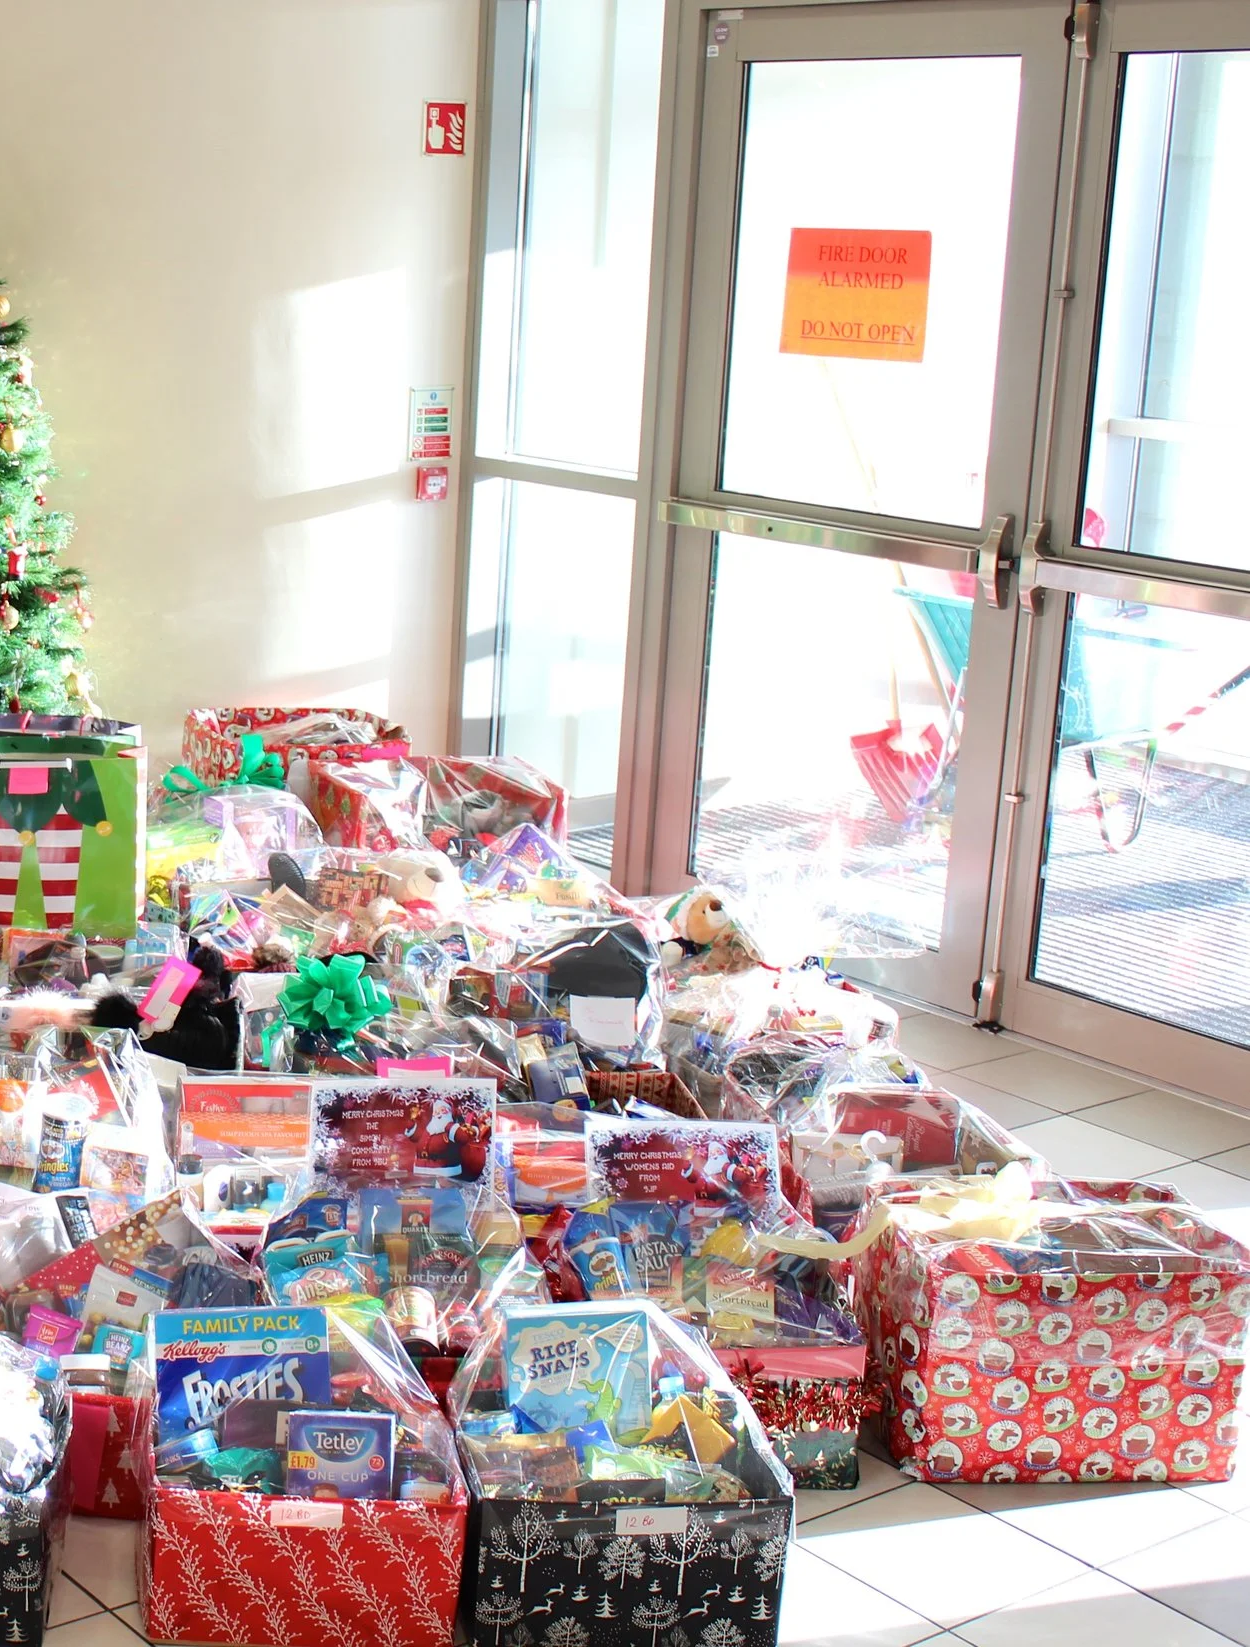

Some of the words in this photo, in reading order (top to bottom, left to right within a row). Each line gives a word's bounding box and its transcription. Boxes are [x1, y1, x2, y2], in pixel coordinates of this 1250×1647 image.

[818, 245, 854, 262] FIRE
[859, 246, 907, 264] DOOR
[818, 271, 903, 290] ALARMED
[801, 319, 825, 336] DO
[829, 321, 864, 339] NOT
[868, 323, 915, 342] OPEN
[342, 1111, 365, 1119] MERRY
[366, 1109, 404, 1118] CHRISTMAS
[366, 1122, 379, 1130] THE
[614, 1152, 638, 1160] MERRY
[640, 1151, 682, 1160] CHRISTMAS
[624, 1163, 660, 1171] WOMENS
[661, 1163, 675, 1171] AID
[639, 1174, 661, 1182] FROM
[635, 1242, 664, 1257] PASTA
[302, 1251, 330, 1266] HEINZ
[636, 1254, 682, 1272] SAUC
[712, 1292, 769, 1309] Shortbread
[183, 1317, 248, 1335] FAMILY
[254, 1314, 301, 1333] PACK
[105, 1341, 131, 1352] BEANZ
[110, 1334, 130, 1344] HEINZ
[163, 1342, 227, 1362] Kellogg's
[531, 1340, 578, 1362] RICE
[182, 1357, 304, 1426] FROSTIES
[313, 1429, 367, 1455] Tetley
[290, 1456, 316, 1469] £1.79
[307, 1470, 335, 1481] ONE
[341, 1471, 369, 1482] CUP
